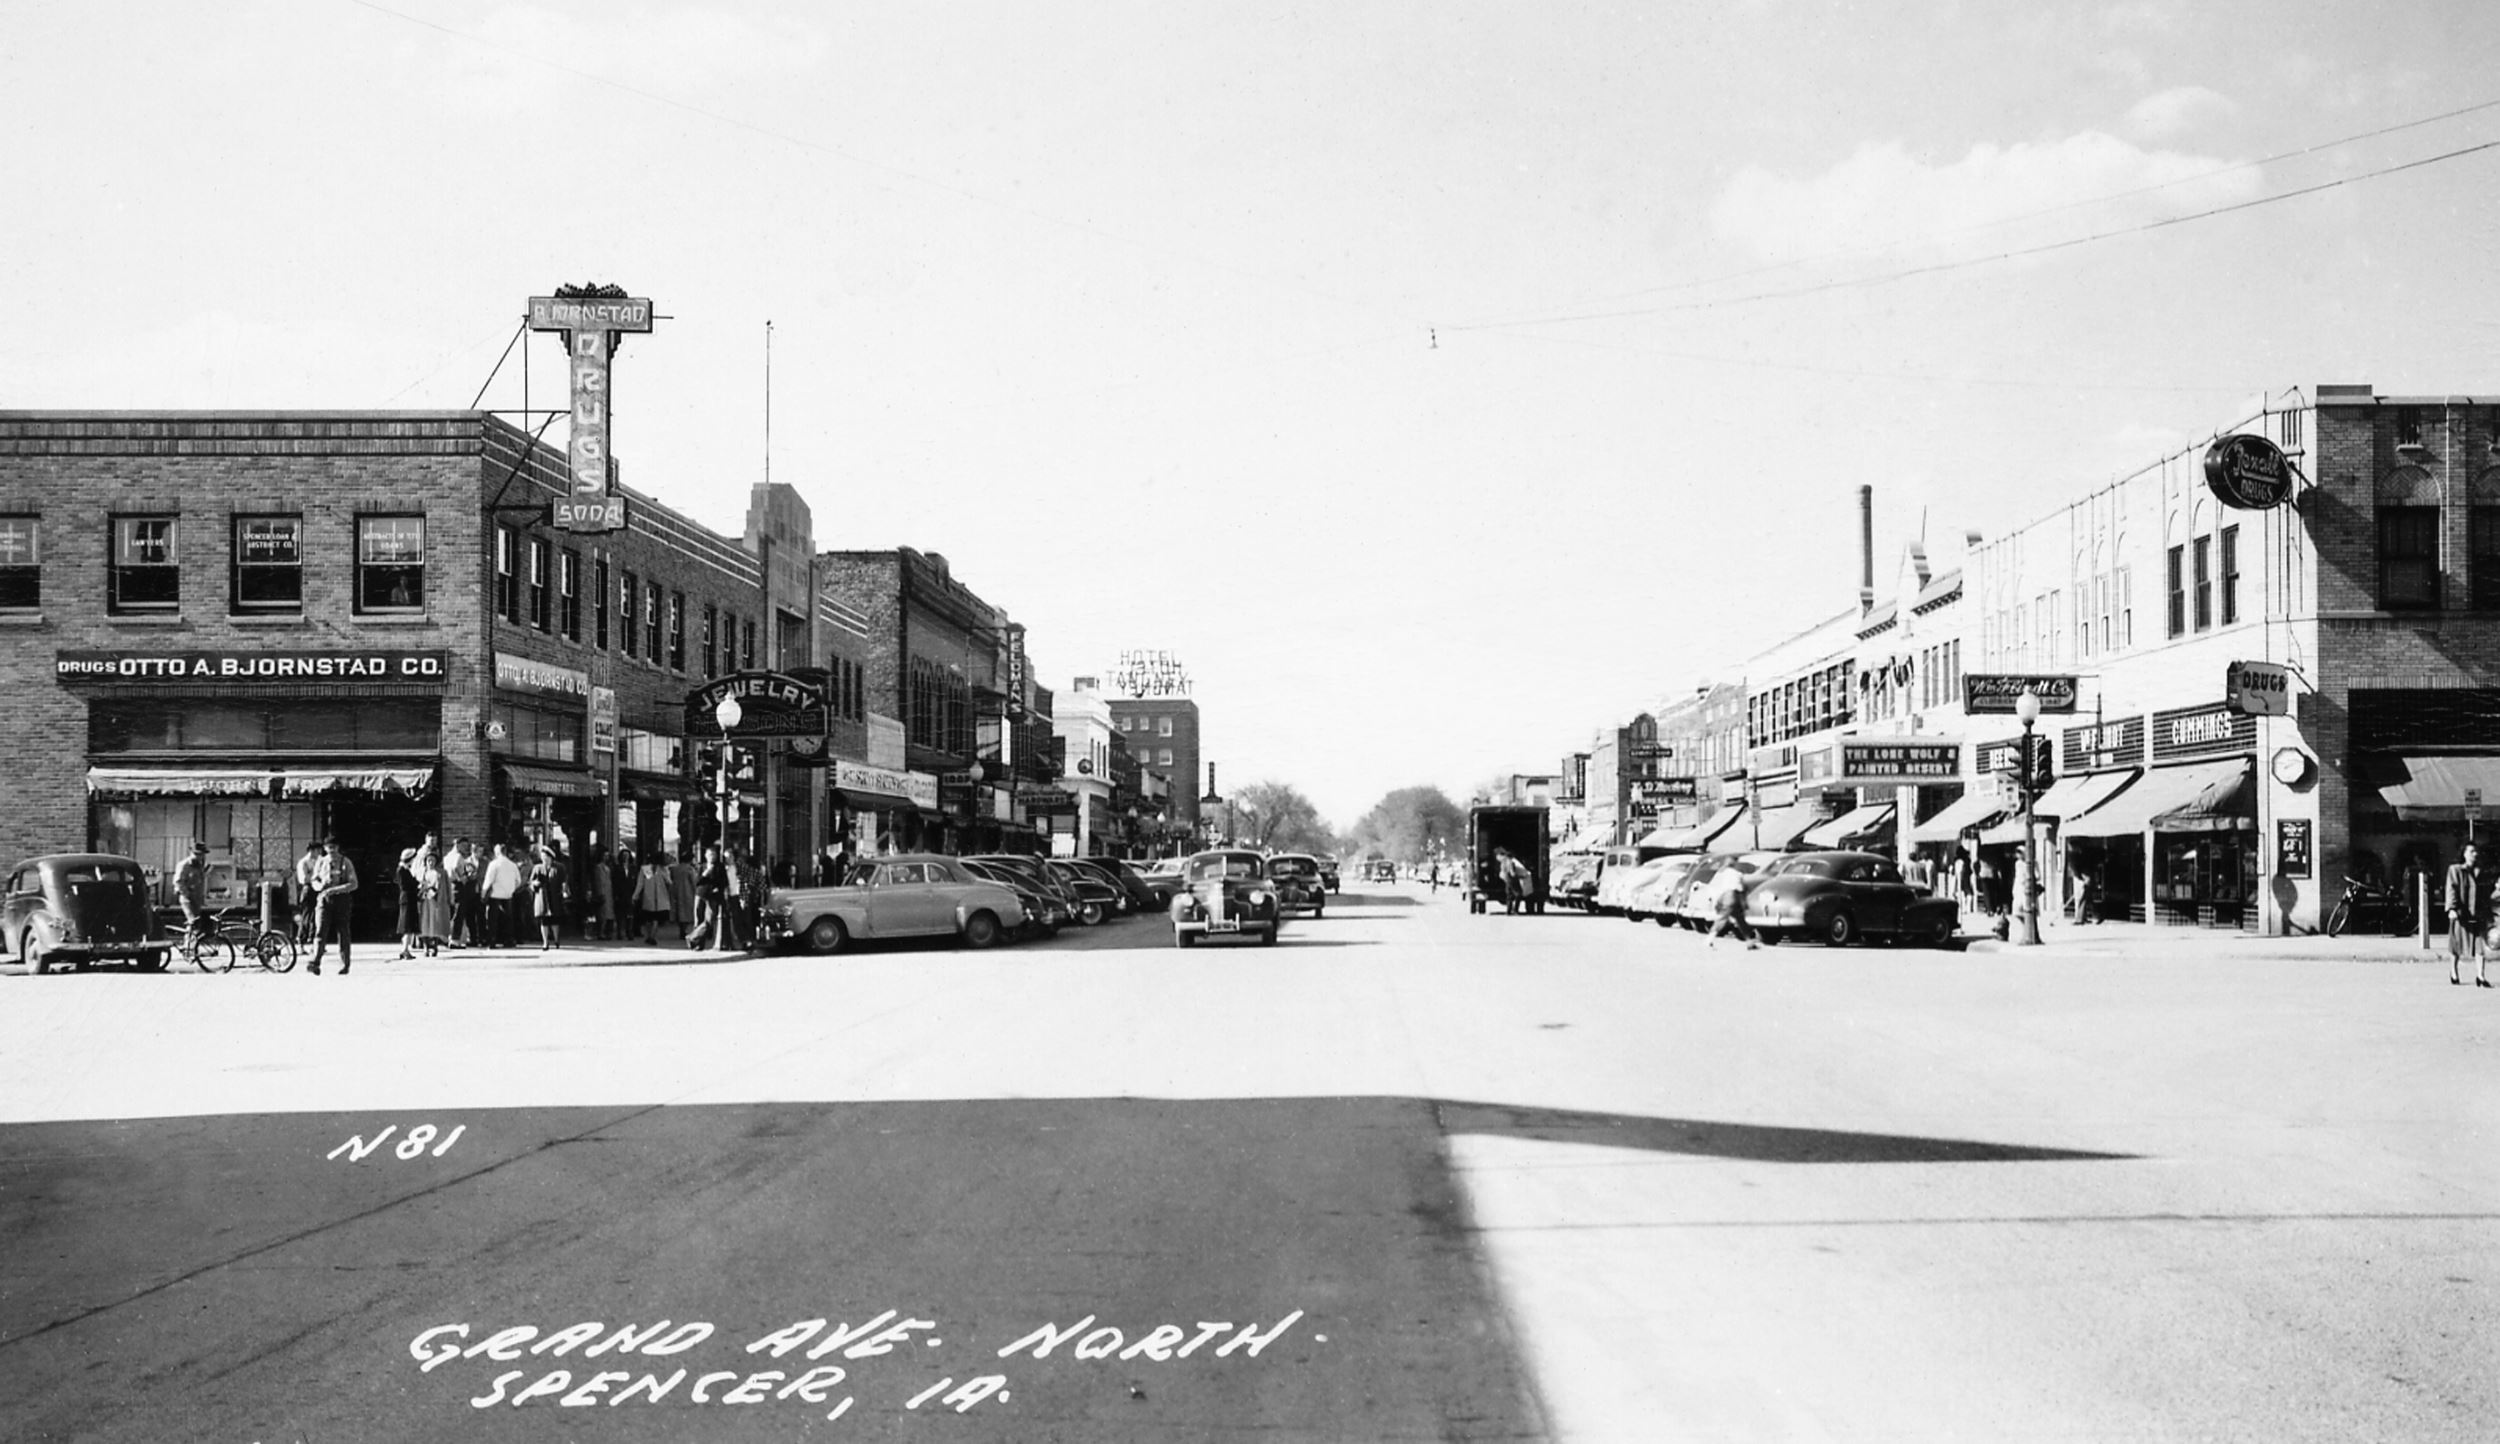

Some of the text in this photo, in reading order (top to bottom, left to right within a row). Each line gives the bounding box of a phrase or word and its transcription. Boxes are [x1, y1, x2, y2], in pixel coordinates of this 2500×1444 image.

[533, 304, 647, 323] BJORNSTAD
[577, 333, 600, 493] DRUGS
[2233, 443, 2279, 477] Rexall
[2241, 479, 2274, 502] DRUGS
[558, 504, 620, 523] SODA
[57, 658, 443, 675] DRUGS OTTO A. BJORNSTAD CO.
[497, 661, 520, 682] OTTO
[1009, 631, 1022, 713] FELDMANS
[2242, 670, 2286, 693] DRUGS
[701, 679, 815, 711] JEWELRY
[2172, 711, 2232, 745] CUMMINGS
[1845, 748, 1869, 760] THE
[1874, 748, 1904, 760] LONE
[1909, 748, 1941, 760] WOLF
[1848, 763, 1952, 774] PAINTED DESERT
